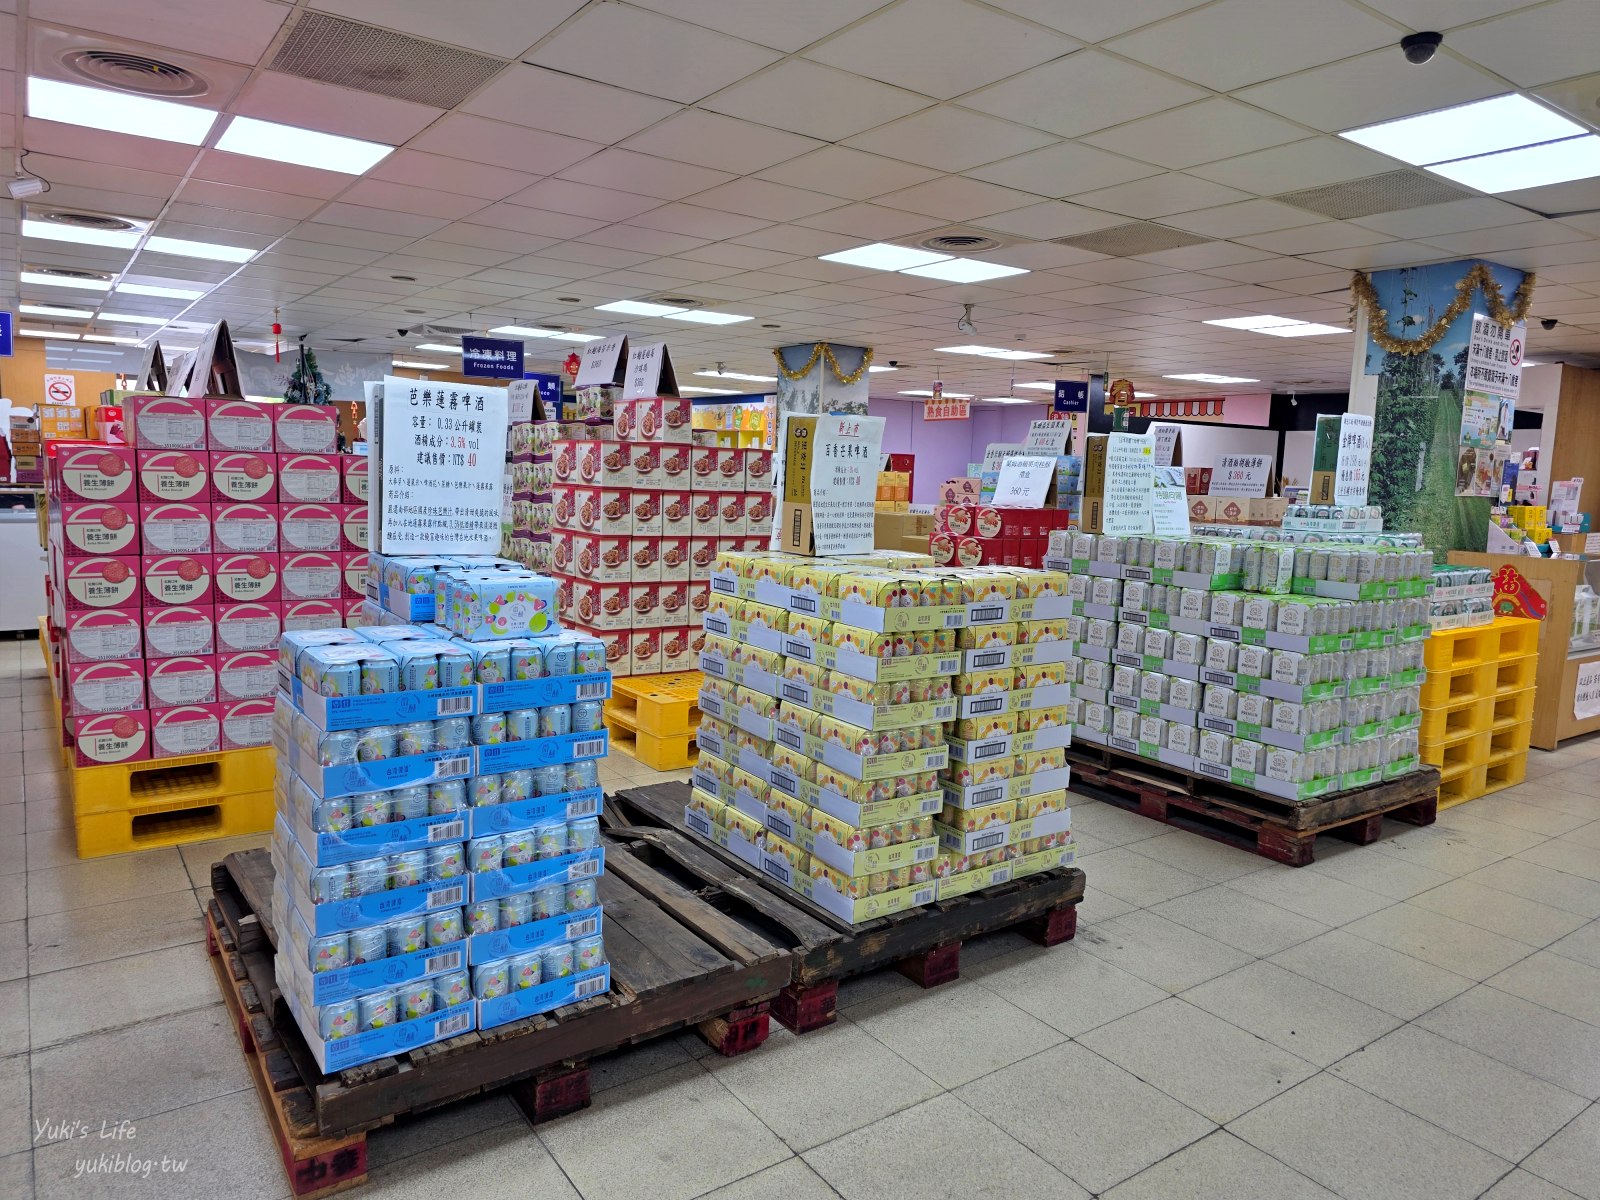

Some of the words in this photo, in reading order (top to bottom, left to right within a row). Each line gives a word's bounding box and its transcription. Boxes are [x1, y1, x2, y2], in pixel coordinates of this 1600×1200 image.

[470, 348, 517, 362] 冷凍料理
[410, 388, 484, 412] 芭樂蓮霧啤酒
[838, 420, 860, 436] 新上市
[469, 439, 479, 450] vol
[467, 453, 477, 466] 40
[98, 742, 128, 751] 養生薄餅
